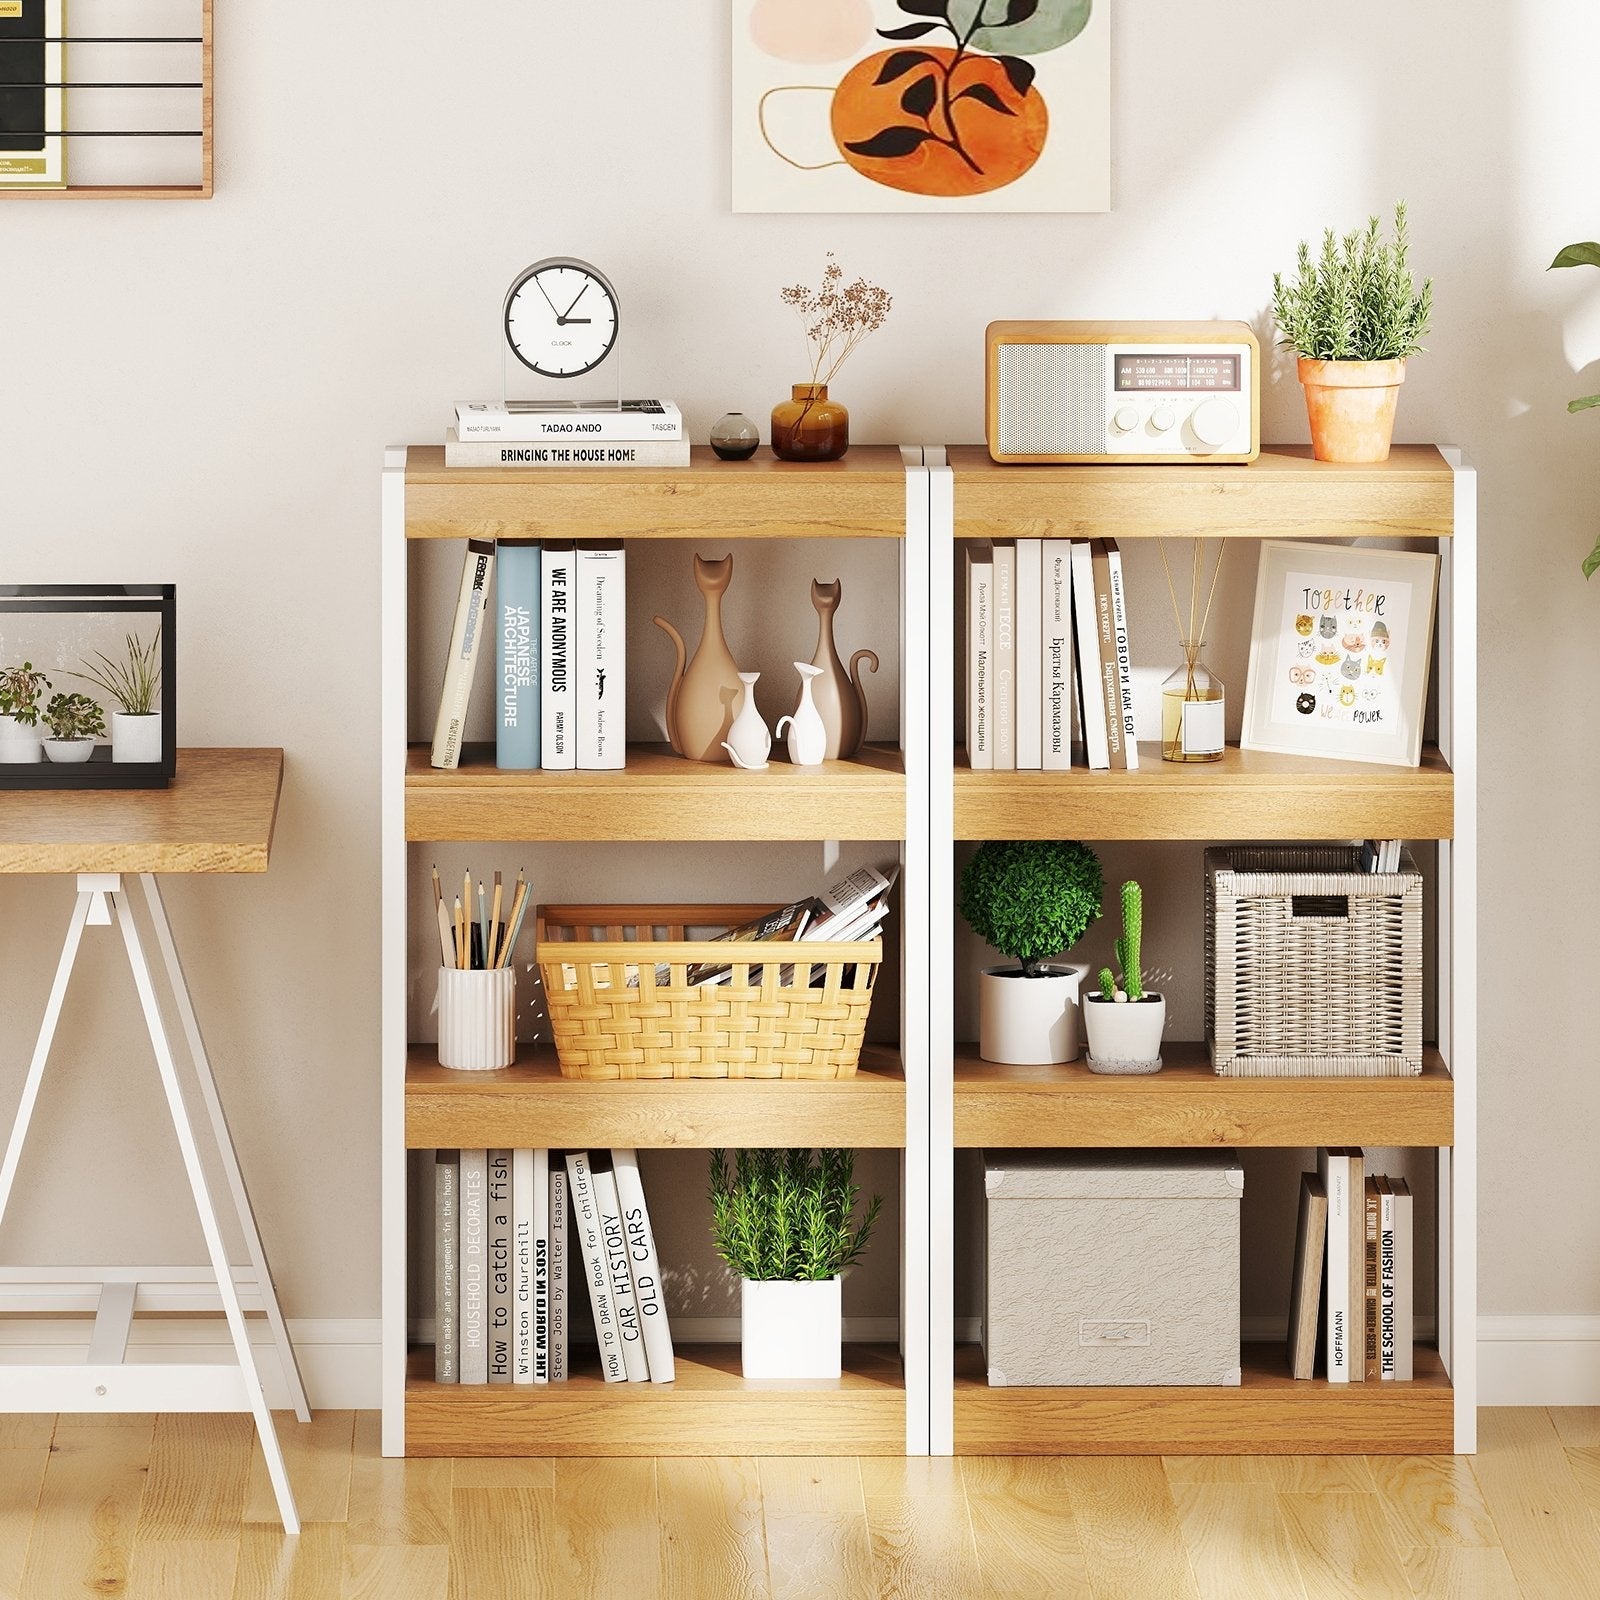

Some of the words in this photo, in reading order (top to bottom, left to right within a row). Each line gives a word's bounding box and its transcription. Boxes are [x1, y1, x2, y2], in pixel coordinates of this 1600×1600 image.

[541, 424, 573, 433] TADAO
[575, 424, 602, 433] ANDO
[501, 449, 548, 462] BRINGING
[551, 449, 570, 462] THE
[573, 449, 605, 462] HOUSE
[608, 449, 635, 462] HOME
[552, 568, 566, 586] WE
[1000, 563, 1008, 604] ГЕРМАН
[552, 590, 566, 613] ARE
[594, 576, 605, 616] Dreaming
[597, 618, 605, 628] of
[1000, 606, 1011, 650] ГЕССЕ
[517, 606, 530, 686] JAPANESE
[529, 638, 537, 656] THE
[552, 617, 566, 692] ANONYMOUS
[597, 628, 605, 660] Sweden
[1049, 638, 1064, 678] Братья
[1117, 627, 1129, 684] ГОВОРИ
[504, 605, 517, 727] ARCHITECTURE
[529, 658, 537, 674] ART
[529, 676, 537, 686] OF
[978, 650, 987, 704] Маленькие
[999, 669, 1012, 724] Степной
[1104, 662, 1117, 715] Бархатная
[1121, 688, 1132, 711] КАК
[556, 712, 564, 733] PARMY
[596, 709, 605, 734] Andrew
[978, 706, 986, 752] женщины
[1049, 682, 1064, 753] Карамазовы
[1124, 715, 1135, 736] БОГ
[556, 735, 564, 754] OLSON
[597, 736, 605, 757] Brown
[1110, 717, 1118, 753] смерть
[443, 1168, 452, 1196] house
[490, 1157, 507, 1202] fish
[575, 1159, 590, 1220] children
[443, 1200, 452, 1216] the
[467, 1170, 481, 1254] DECORATES
[553, 1174, 562, 1230] Isaacson
[1366, 1198, 1376, 1211] J.K.
[443, 1221, 452, 1233] in
[494, 1215, 507, 1225] a
[628, 1208, 649, 1261] CARS
[1366, 1212, 1376, 1240] ROWLING
[586, 1228, 596, 1250] for
[1366, 1242, 1376, 1262] HARRY
[443, 1238, 454, 1297] arrangement
[491, 1238, 507, 1295] catch
[518, 1220, 529, 1302] Churchill
[553, 1237, 562, 1280] Walter
[602, 1214, 632, 1295] HISTORY
[1382, 1230, 1394, 1280] FASHION
[593, 1257, 602, 1288] Book
[1366, 1264, 1376, 1287] POTTER
[553, 1286, 564, 1302] by
[638, 1276, 659, 1317] OLD
[1382, 1282, 1394, 1298] OF
[443, 1301, 452, 1313] an
[467, 1263, 481, 1348] HOUSEHOLD
[492, 1306, 507, 1328] to
[599, 1294, 610, 1325] DRAW
[1366, 1298, 1376, 1328] CHAMBER
[443, 1317, 452, 1340] make
[553, 1308, 562, 1336] Jobs
[620, 1306, 639, 1342] CAR
[1382, 1300, 1394, 1348] SCHOOL
[443, 1344, 452, 1355] to
[518, 1310, 529, 1374] Winston
[604, 1332, 614, 1348] TO
[1335, 1311, 1343, 1366] HOFFMANN
[1366, 1332, 1376, 1360] SECRETS
[443, 1360, 452, 1377] How
[492, 1340, 507, 1375] How
[553, 1343, 563, 1378] Steve
[609, 1354, 619, 1378] HOW
[1382, 1348, 1394, 1374] THE
